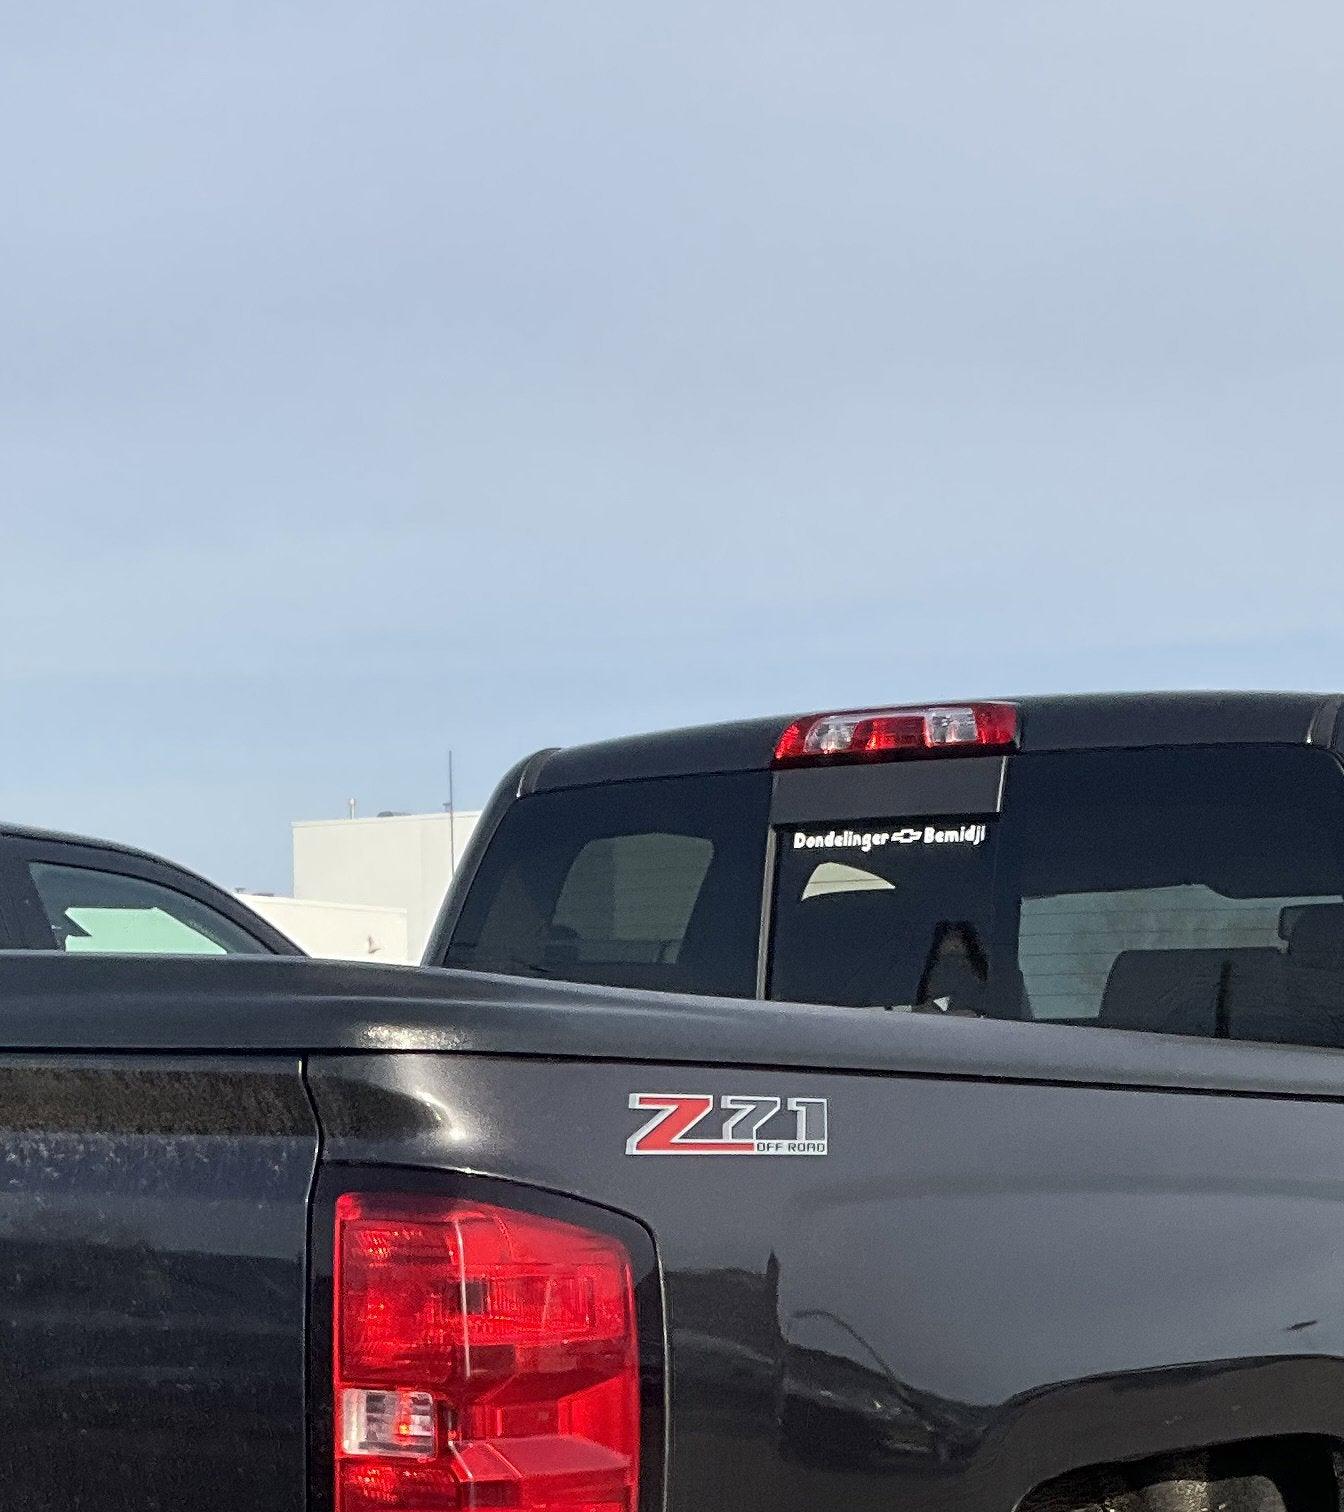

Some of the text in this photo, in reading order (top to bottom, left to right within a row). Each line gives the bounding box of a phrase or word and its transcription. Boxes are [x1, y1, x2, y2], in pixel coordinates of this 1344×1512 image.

[793, 824, 987, 853] Dondelinger Bemidji
[625, 1093, 828, 1155] Z71
[756, 1142, 826, 1153] OFF ROAD
